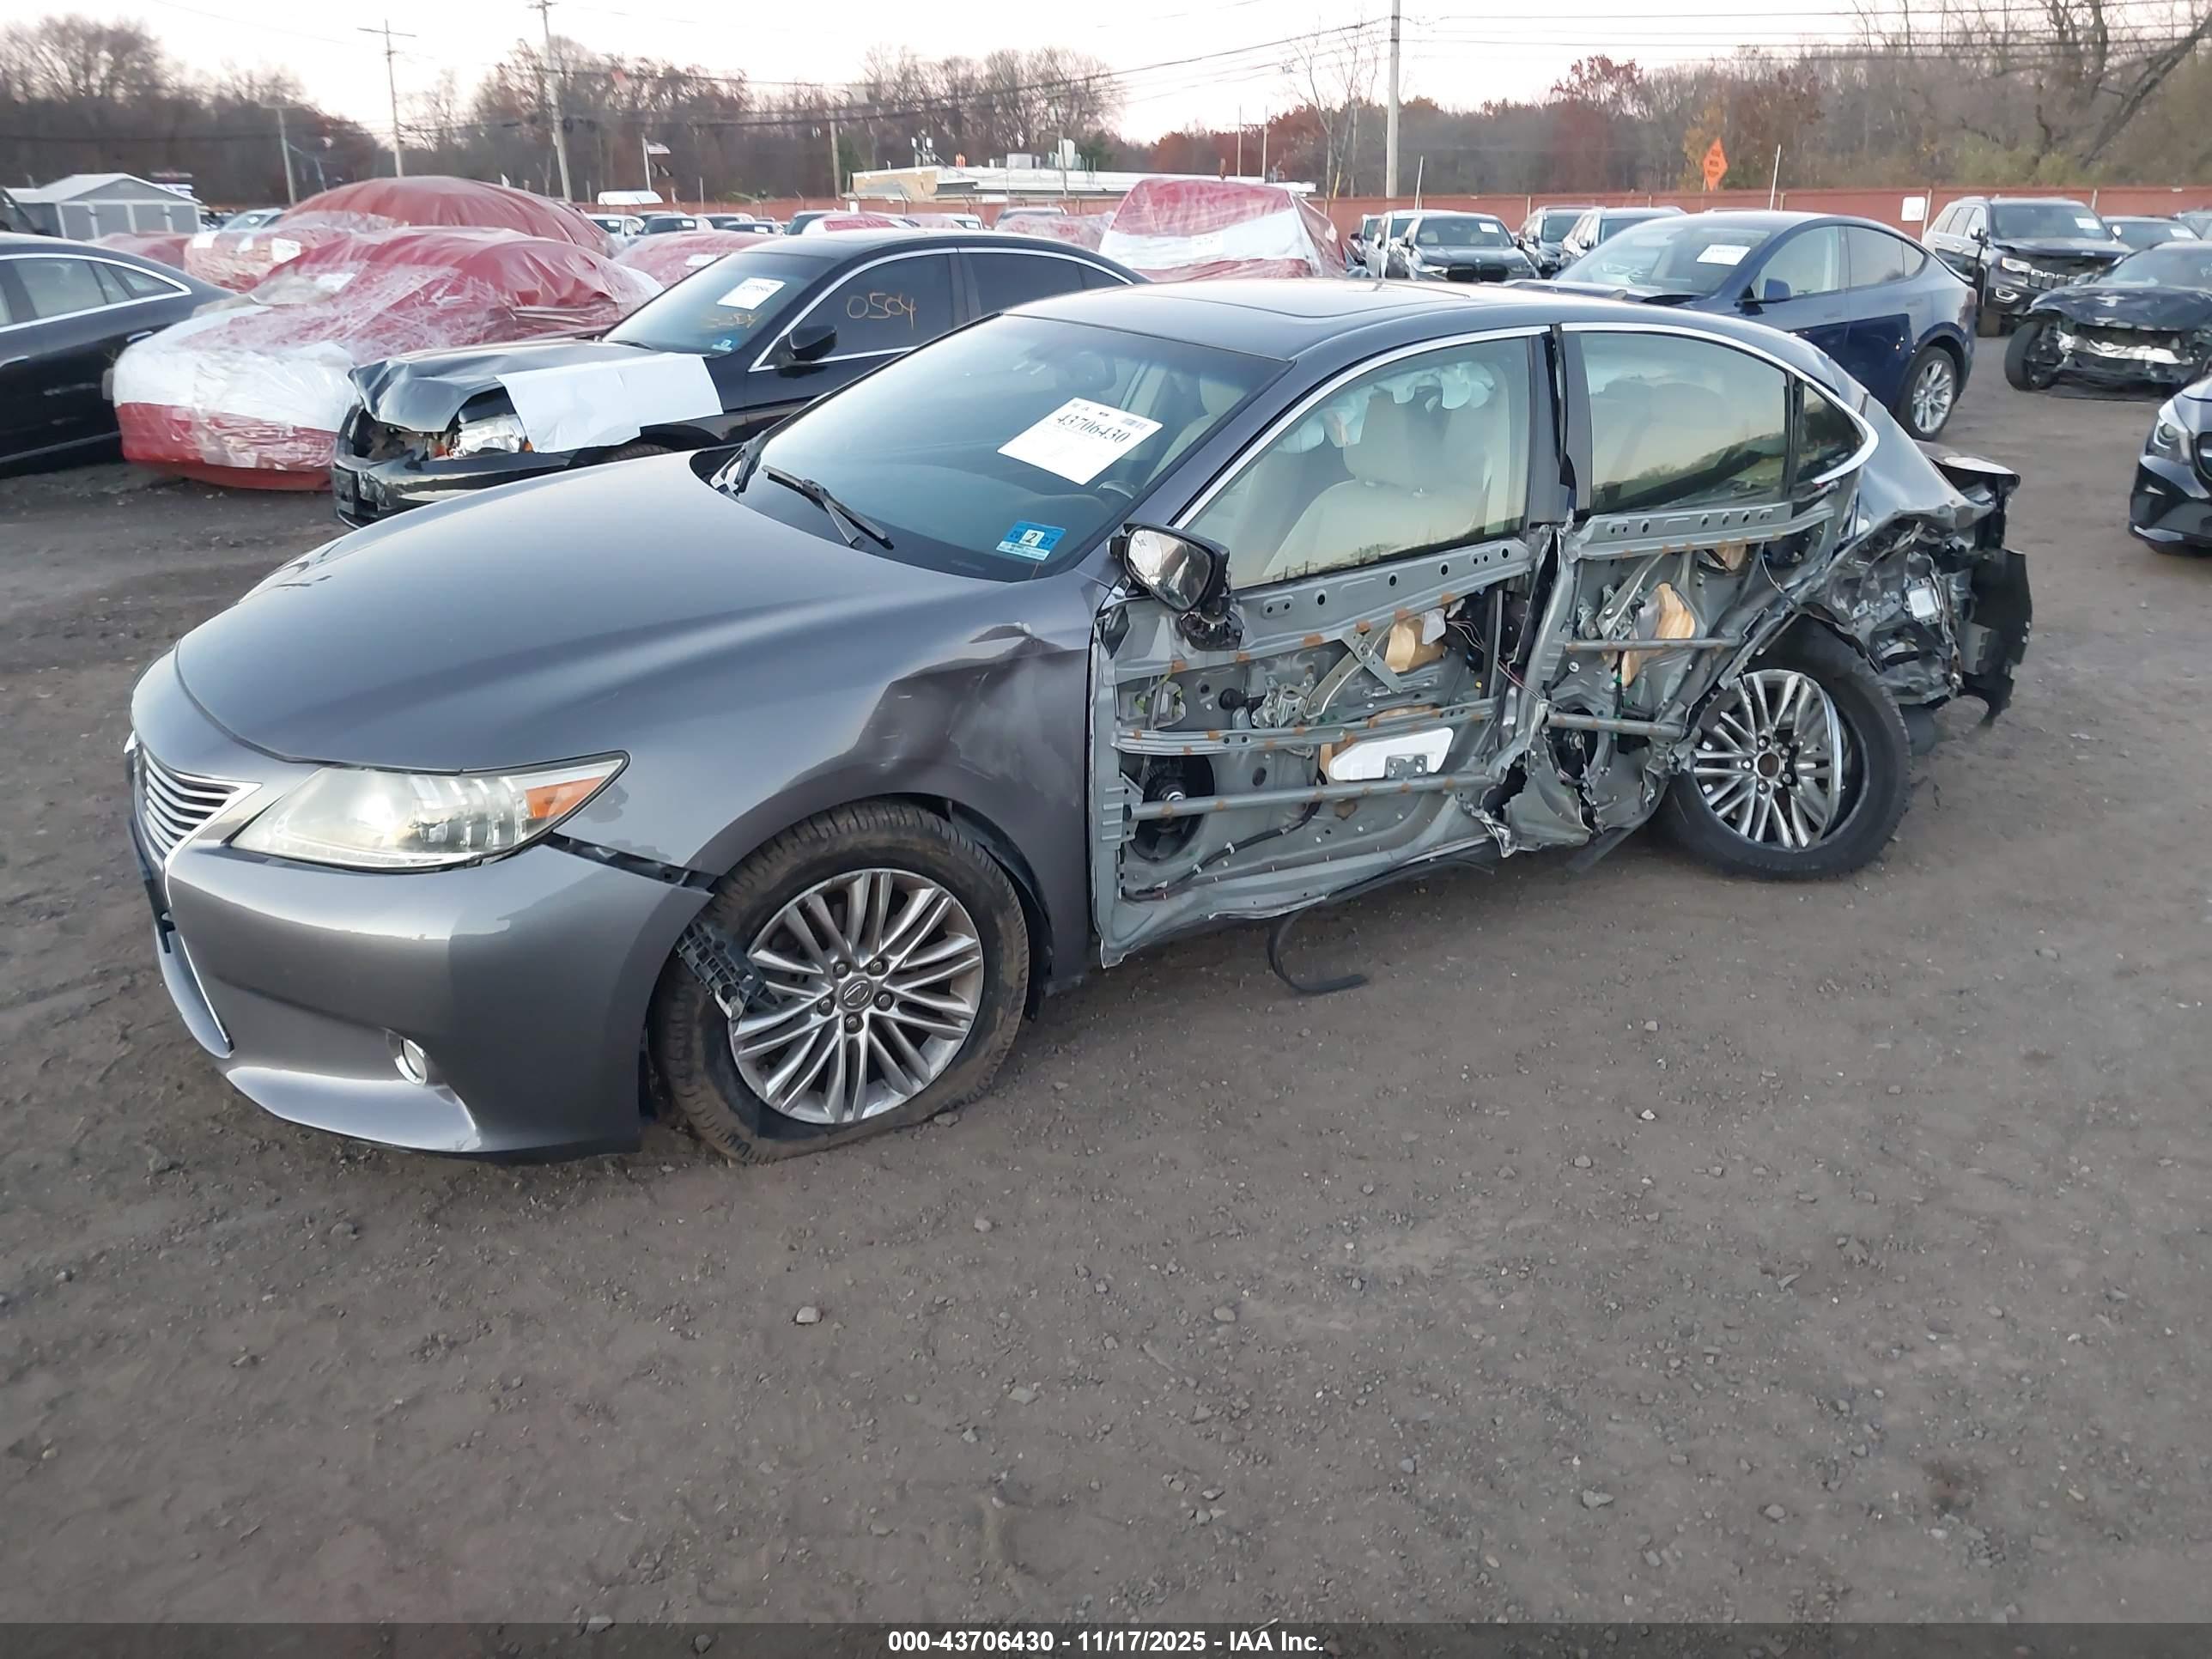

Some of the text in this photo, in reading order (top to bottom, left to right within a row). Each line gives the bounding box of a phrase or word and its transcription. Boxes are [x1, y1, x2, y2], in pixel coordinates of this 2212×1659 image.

[847, 292, 916, 330] 0504
[1058, 414, 1131, 443] 43706430
[1024, 532, 1037, 544] 2
